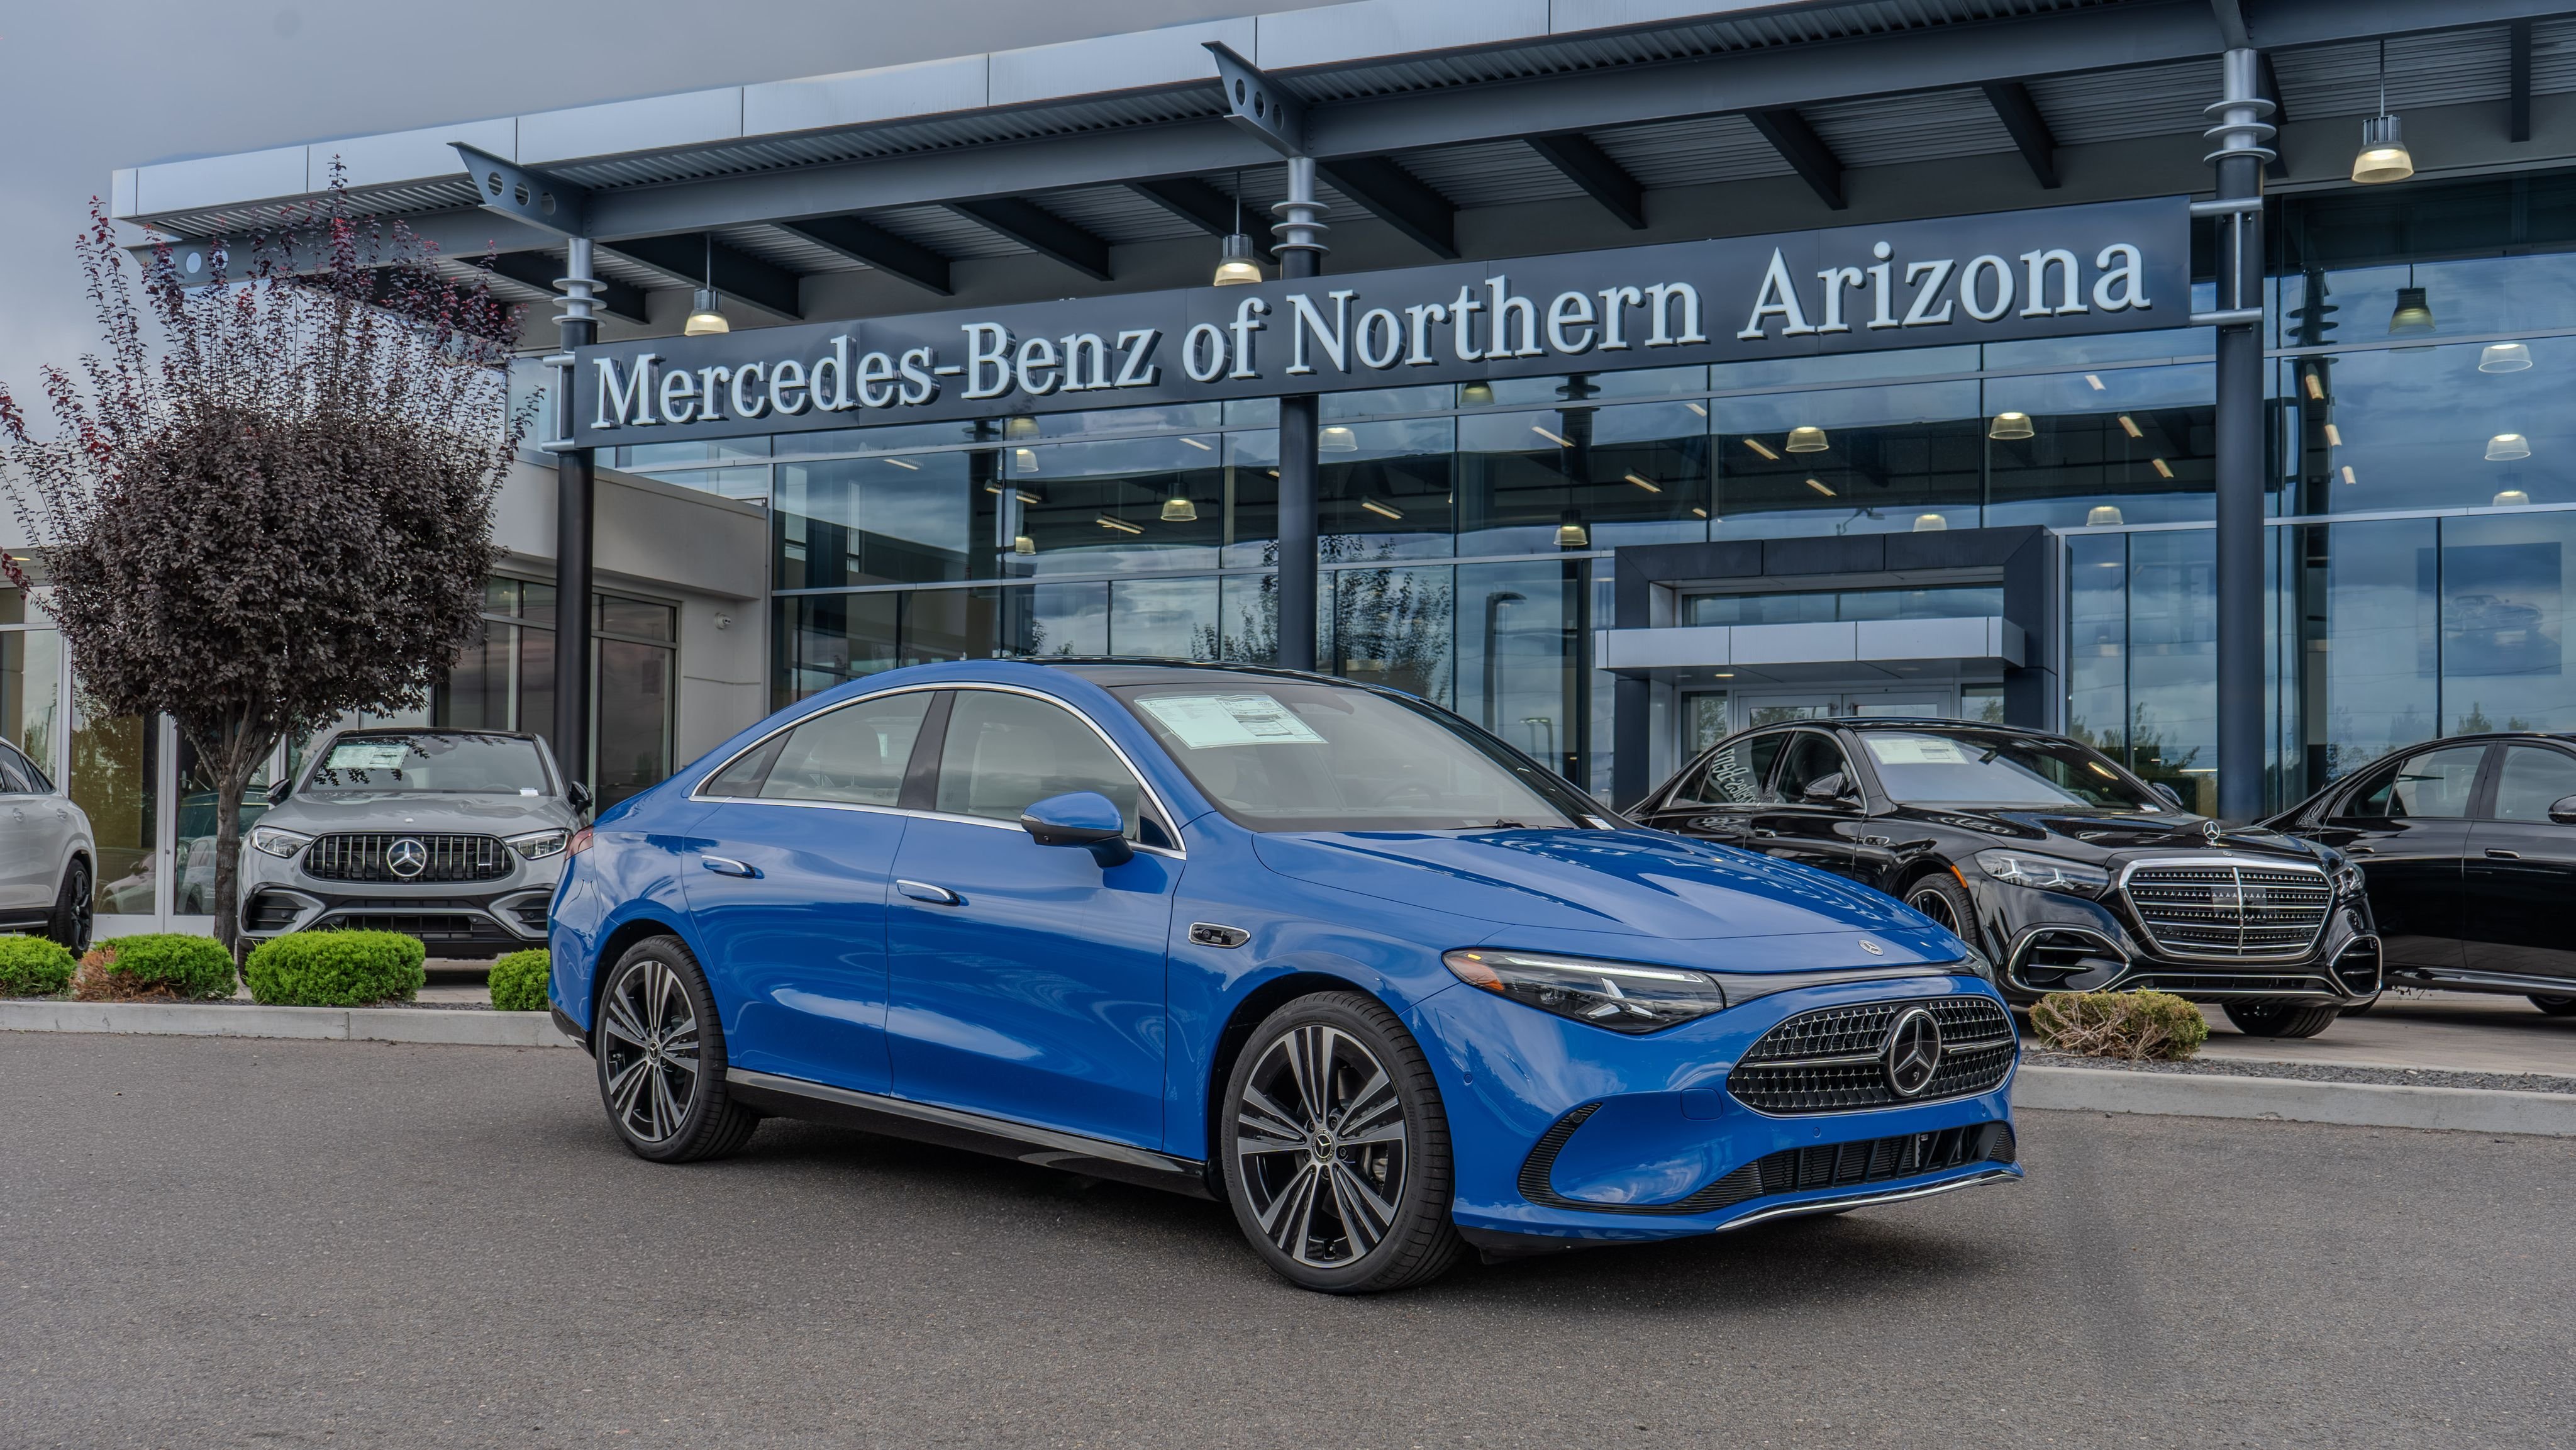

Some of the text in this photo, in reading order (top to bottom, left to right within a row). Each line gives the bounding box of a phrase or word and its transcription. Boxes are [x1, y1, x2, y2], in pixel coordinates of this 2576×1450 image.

[591, 241, 2151, 429] Mercedes-Benz of Northern Arizona
[1225, 1116, 1235, 1188] BRIDGESTONE
[1406, 1101, 1419, 1177] BRIDGESTONE
